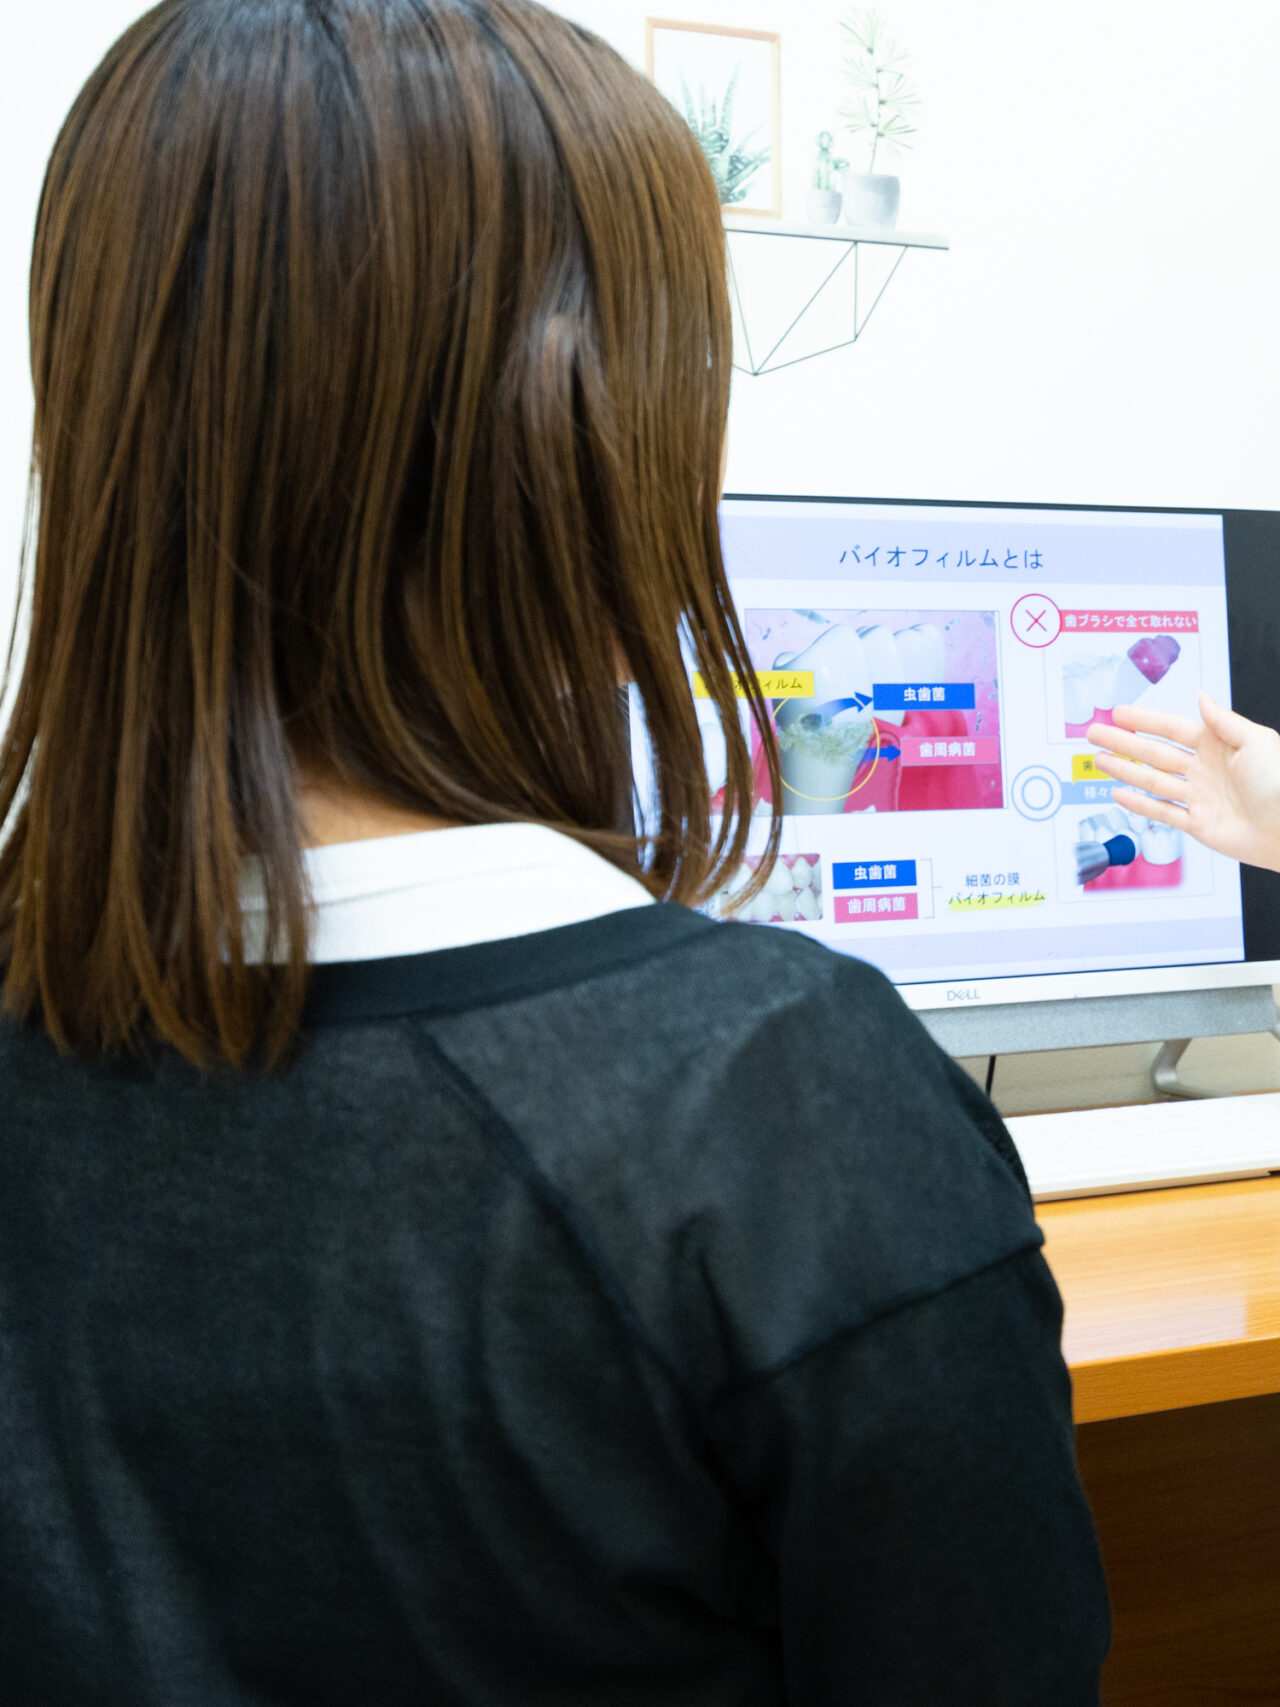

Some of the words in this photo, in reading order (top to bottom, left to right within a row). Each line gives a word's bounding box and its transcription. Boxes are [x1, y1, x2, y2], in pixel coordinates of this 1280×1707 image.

[839, 544, 1044, 570] バイオフィルムとは
[1064, 613, 1197, 628] 歯ブラシで全て取れない
[903, 686, 946, 702] 虫歯菌
[919, 741, 976, 758] 歯周病菌
[854, 864, 897, 881] 虫歯菌
[965, 872, 1021, 888] 細菌の膜
[848, 896, 907, 915] 歯周病菌
[948, 889, 1046, 906] バイオフィルム
[946, 988, 981, 1002] DELL
